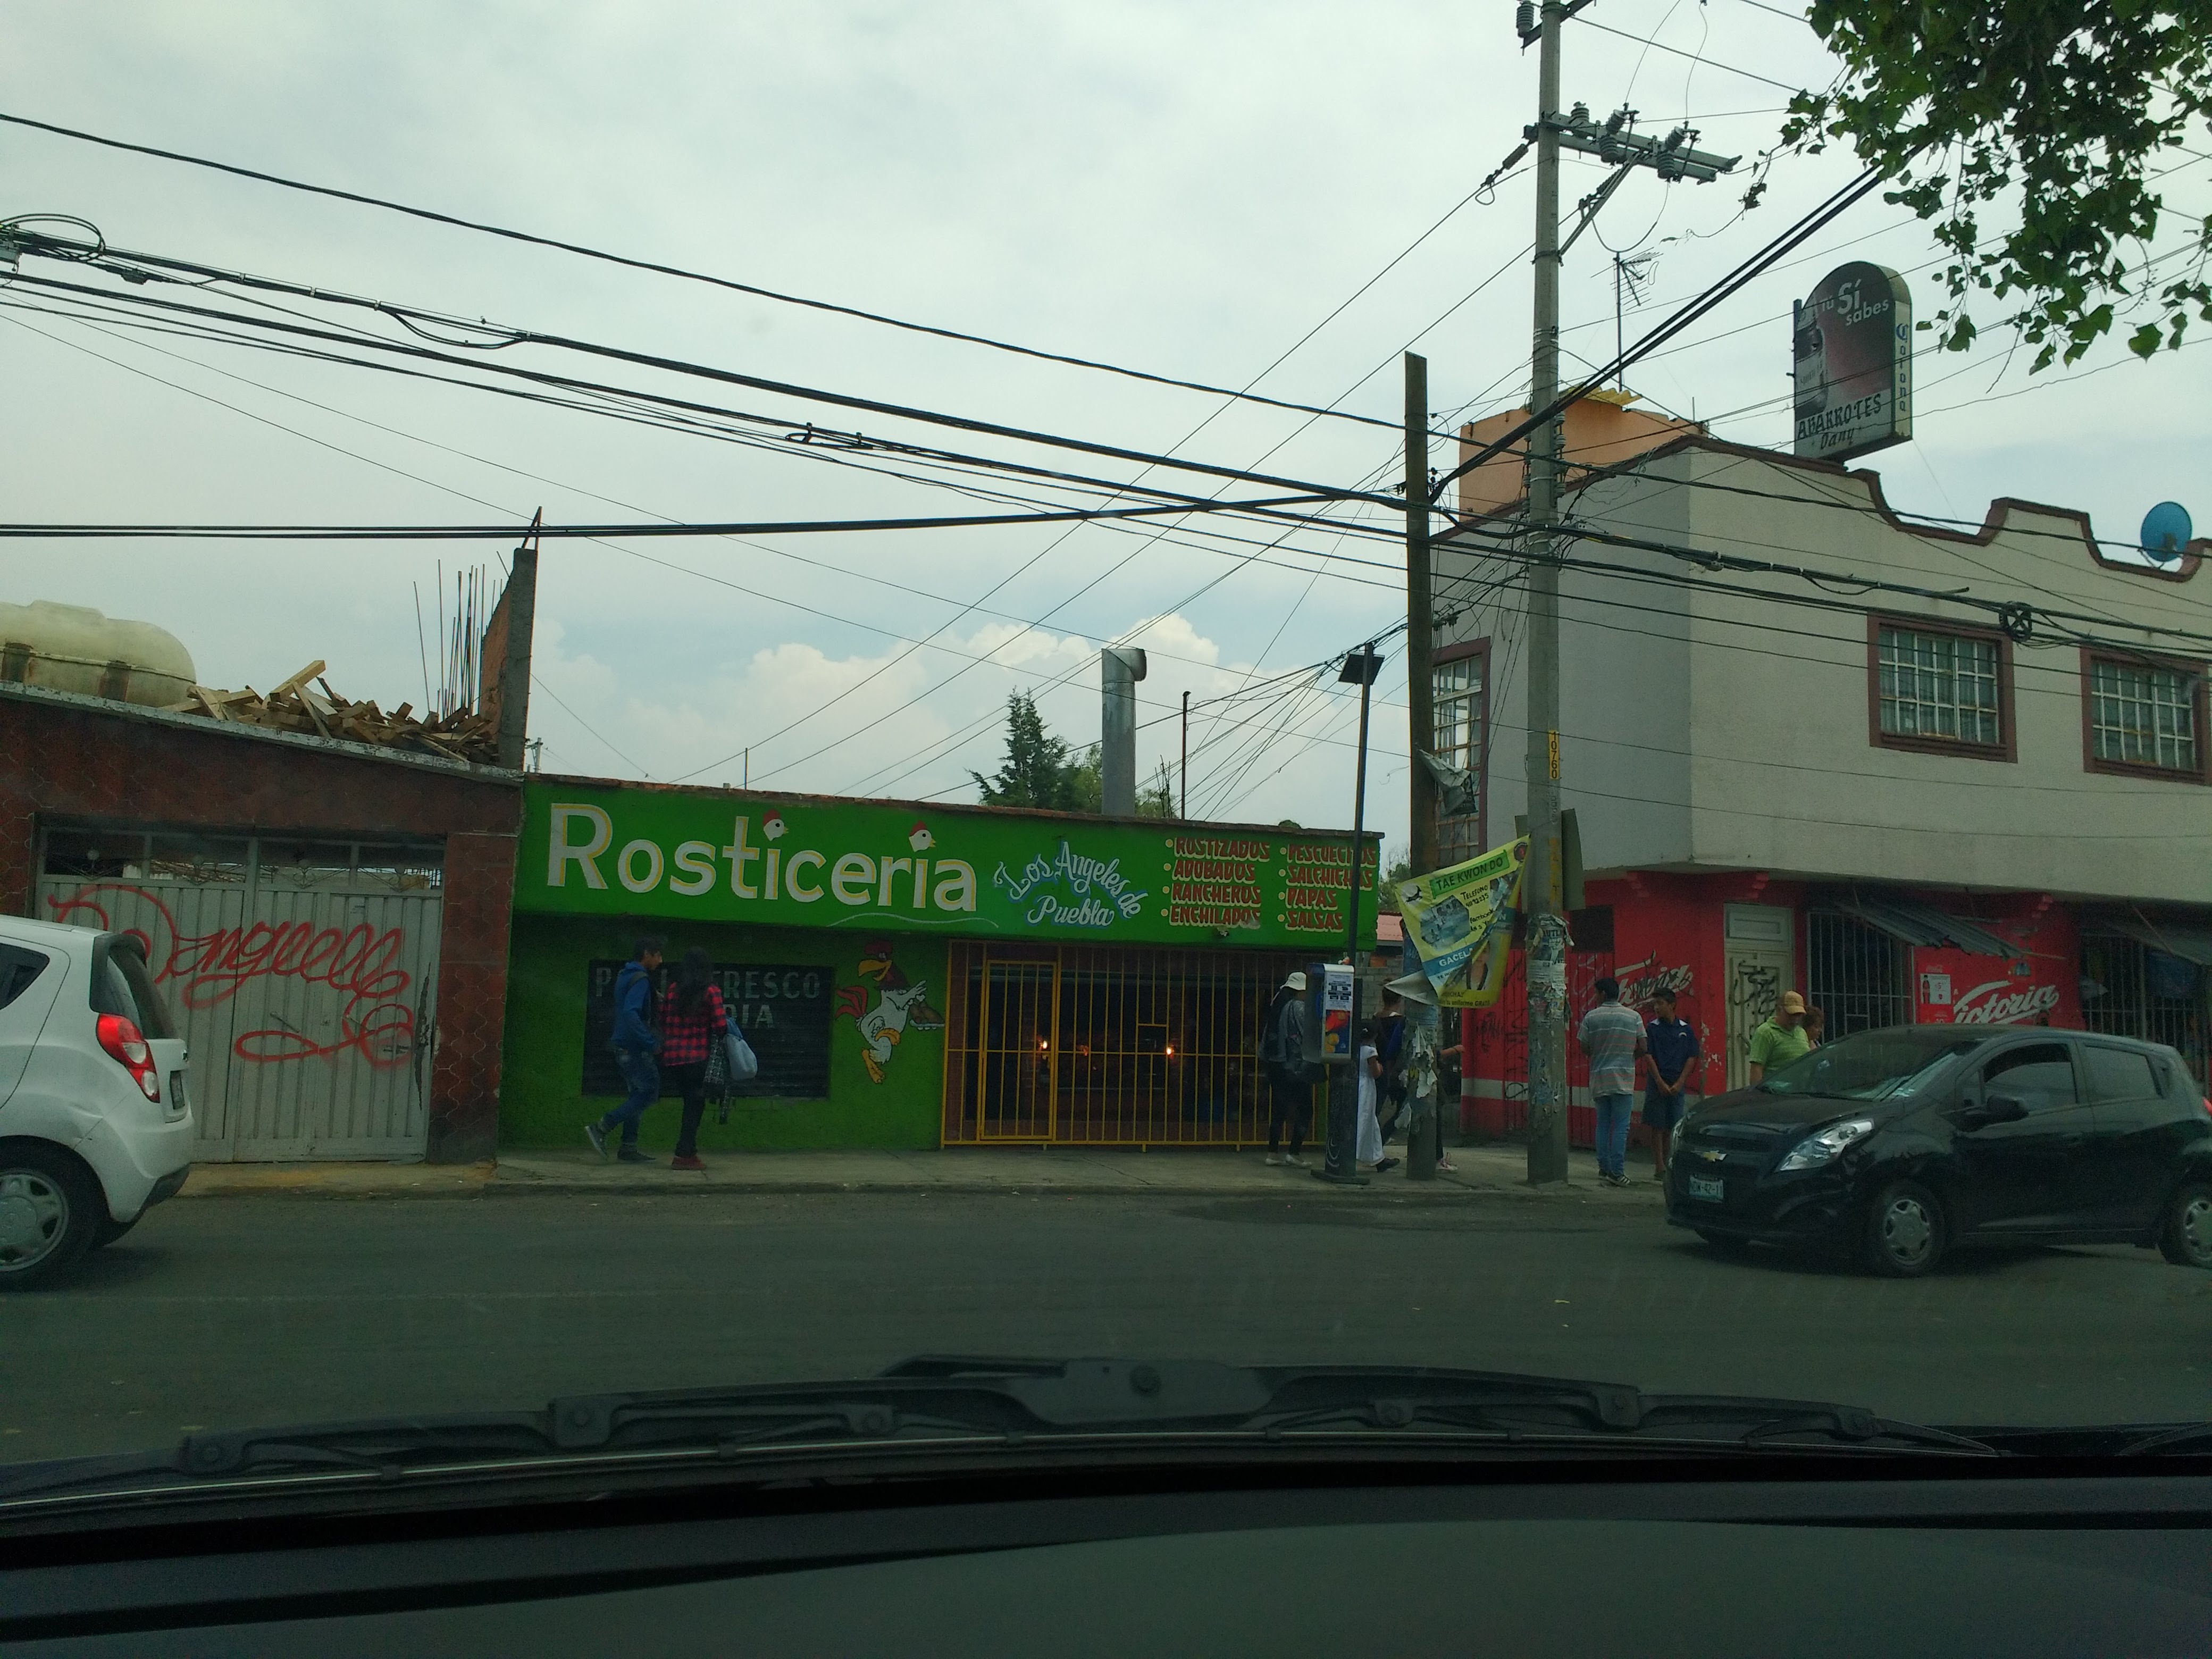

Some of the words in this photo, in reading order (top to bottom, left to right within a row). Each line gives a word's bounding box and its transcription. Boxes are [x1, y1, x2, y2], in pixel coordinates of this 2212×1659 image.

[1837, 279, 1862, 315] Sí
[1845, 299, 1889, 326] sabes
[1821, 428, 1855, 449] Dany
[547, 803, 977, 912] Rosticeria
[1174, 836, 1270, 862] ROSTIZADOS
[1287, 843, 1376, 868] PESCUECIOS
[994, 853, 1054, 900] Los
[1055, 841, 1131, 898] Angeles
[1117, 892, 1149, 919] de
[1171, 858, 1255, 884] ADOBADOS
[1285, 865, 1373, 891] SALCHICHS
[1436, 875, 1455, 891] TAE
[1457, 864, 1487, 883] KWON
[1489, 857, 1503, 870] DO
[1170, 883, 1261, 908] RANCHEROS
[1285, 888, 1338, 910] PAPAS
[1027, 895, 1115, 926] Puebla
[1169, 905, 1261, 929] ENCHILADOS
[1285, 910, 1344, 933] SALSAS
